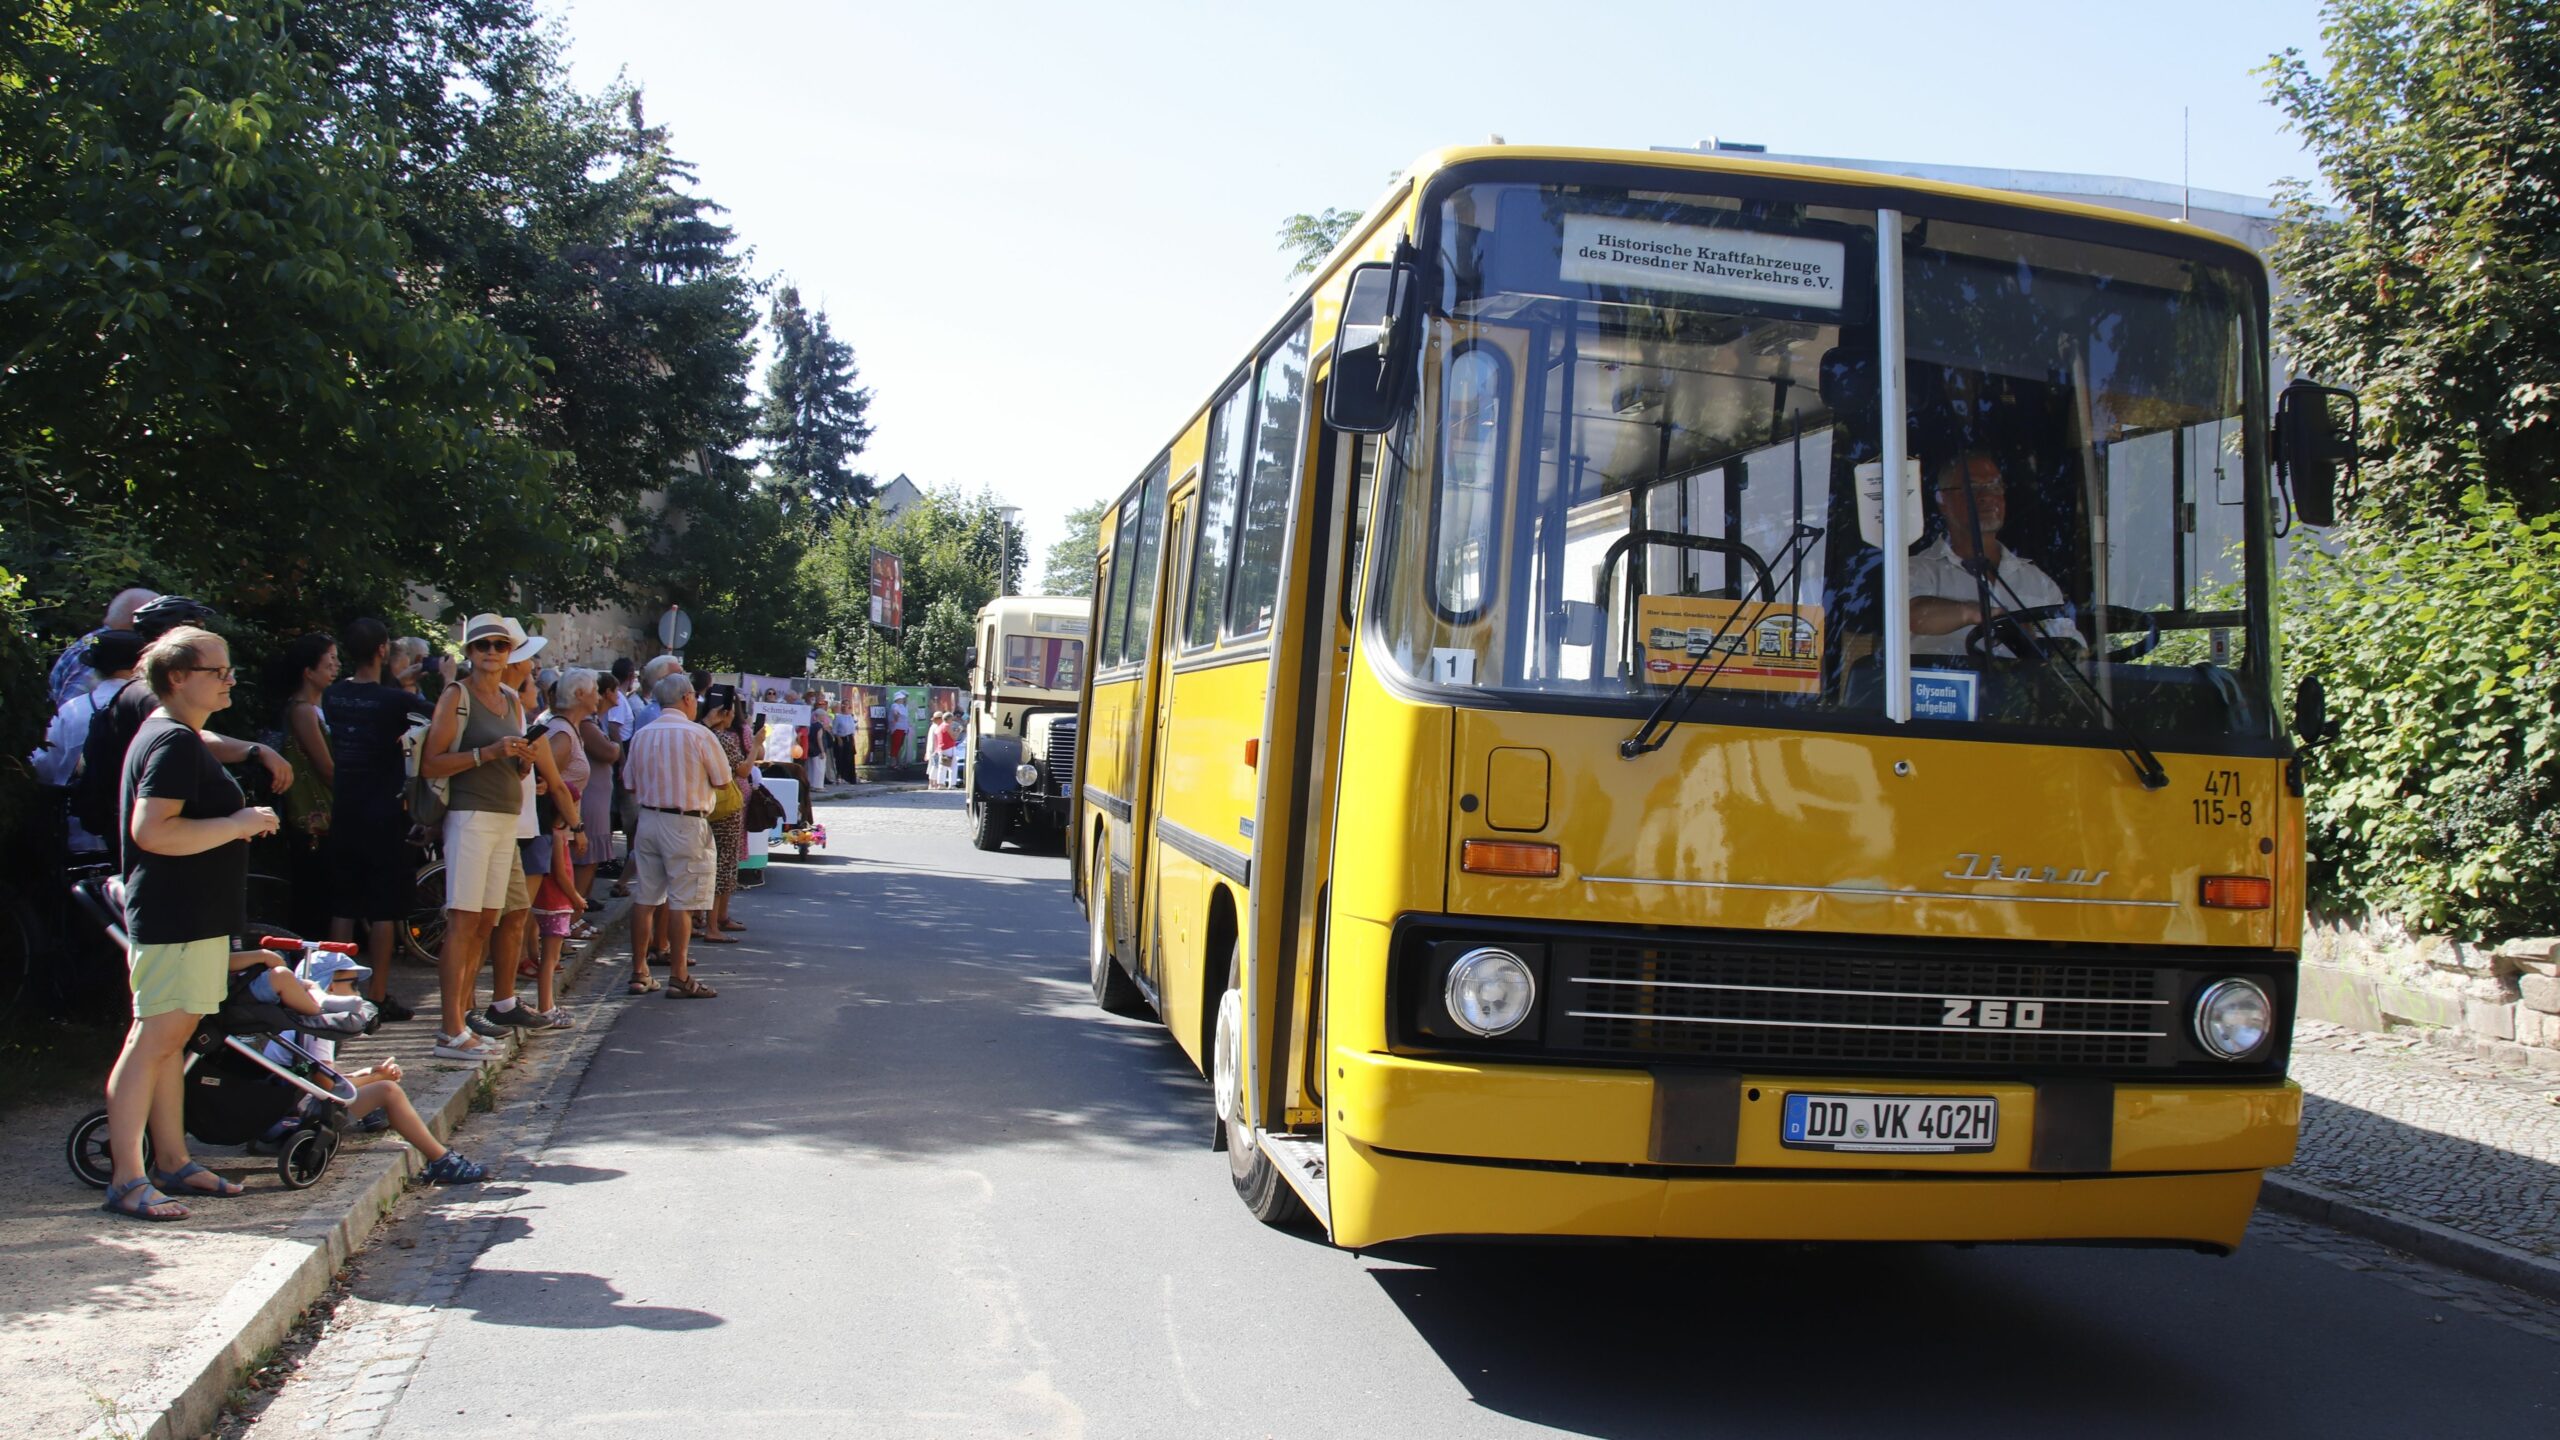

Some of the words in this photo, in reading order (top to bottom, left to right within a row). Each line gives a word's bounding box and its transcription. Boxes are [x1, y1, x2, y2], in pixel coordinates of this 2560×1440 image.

[1578, 246, 1607, 260] des
[1611, 249, 1689, 271] Dresdner
[1693, 260, 1799, 286] Nahverkehrs
[1803, 276, 1833, 290] e.V.
[1597, 233, 1693, 258] Historische
[1697, 246, 1821, 276] Kraftfahrzeuge
[1446, 655, 1457, 678] 1
[1915, 683, 1957, 699] Glysantin
[762, 705, 798, 715] Schmiede
[1003, 711, 1014, 730] 4
[1915, 701, 1957, 715] aufgefüllt
[2204, 770, 2241, 797] 471
[2193, 798, 2253, 826] 115-8
[1943, 853, 2110, 886] Ikarus
[1807, 1101, 1849, 1137] DD
[1873, 1103, 1911, 1139] VK
[1917, 1104, 1991, 1140] 402H
